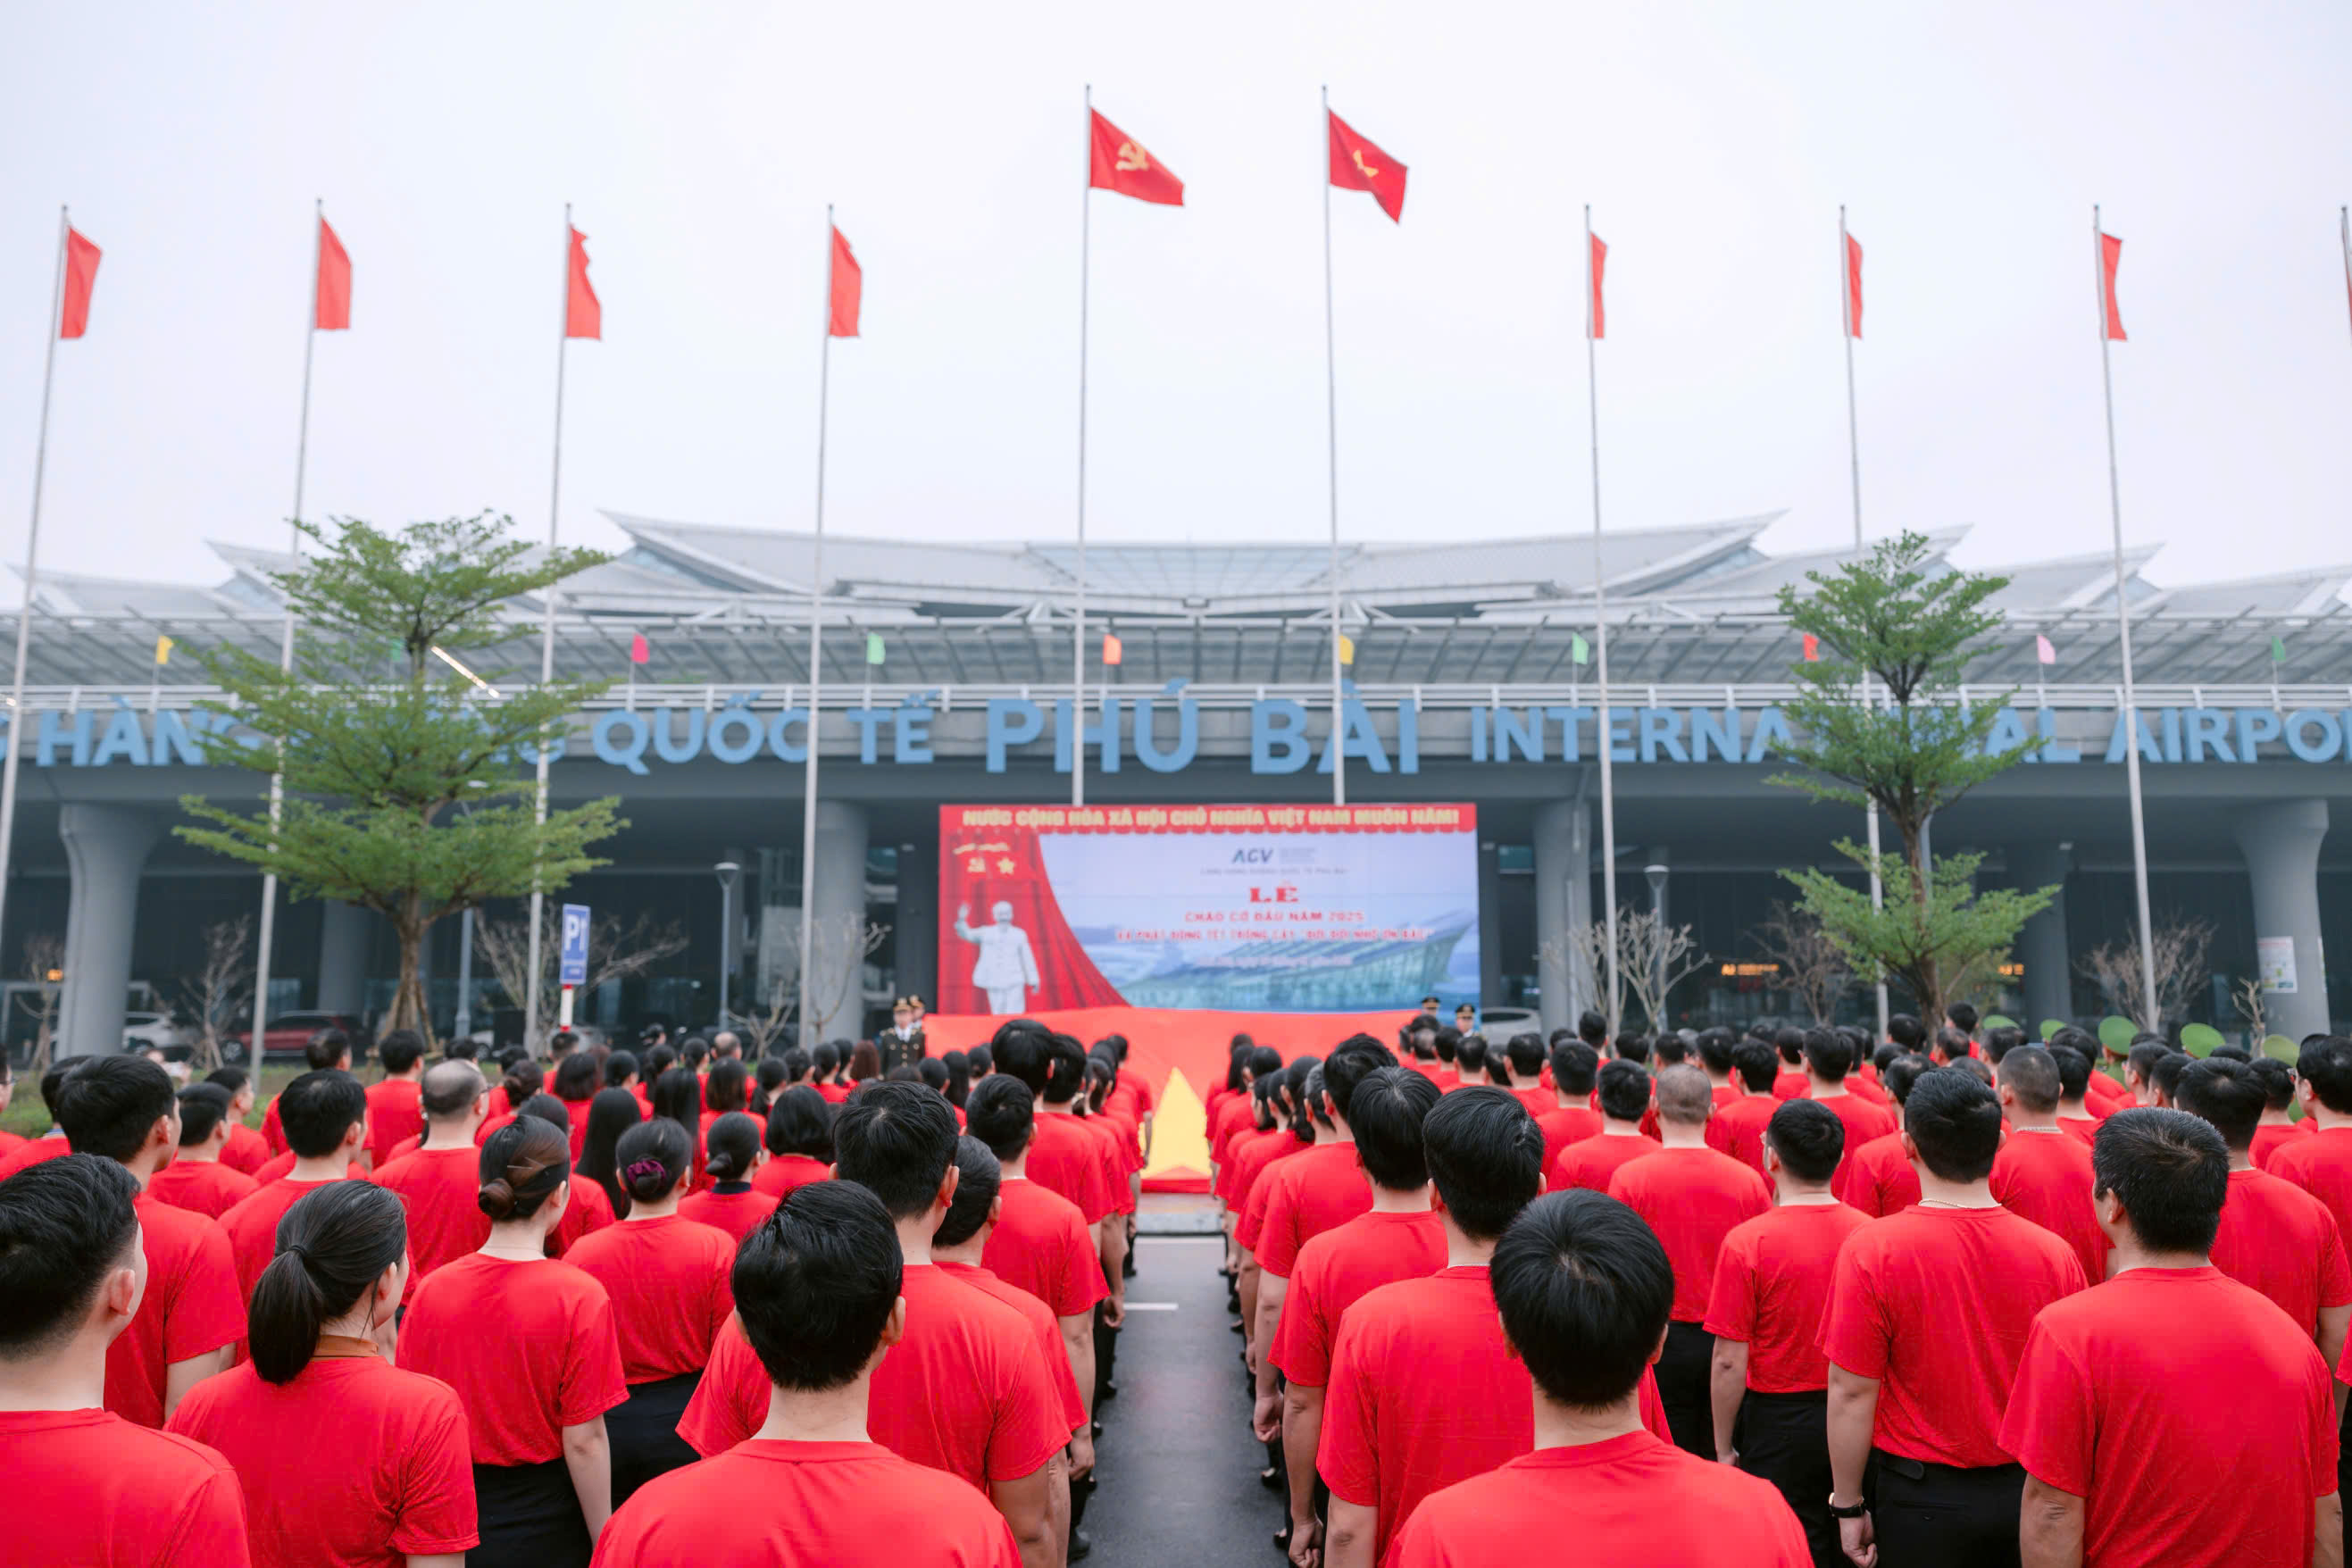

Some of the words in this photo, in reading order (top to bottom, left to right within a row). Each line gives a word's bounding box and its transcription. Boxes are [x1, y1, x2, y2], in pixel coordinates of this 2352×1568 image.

[592, 689, 809, 775] QUỐC
[847, 688, 941, 764] TẾ
[986, 678, 1199, 773] PHÚ
[1252, 679, 1420, 774] BÀI
[1472, 705, 2081, 763] INTERNAAL
[2105, 705, 2352, 763] AIRPO
[1231, 849, 1273, 863] ACV
